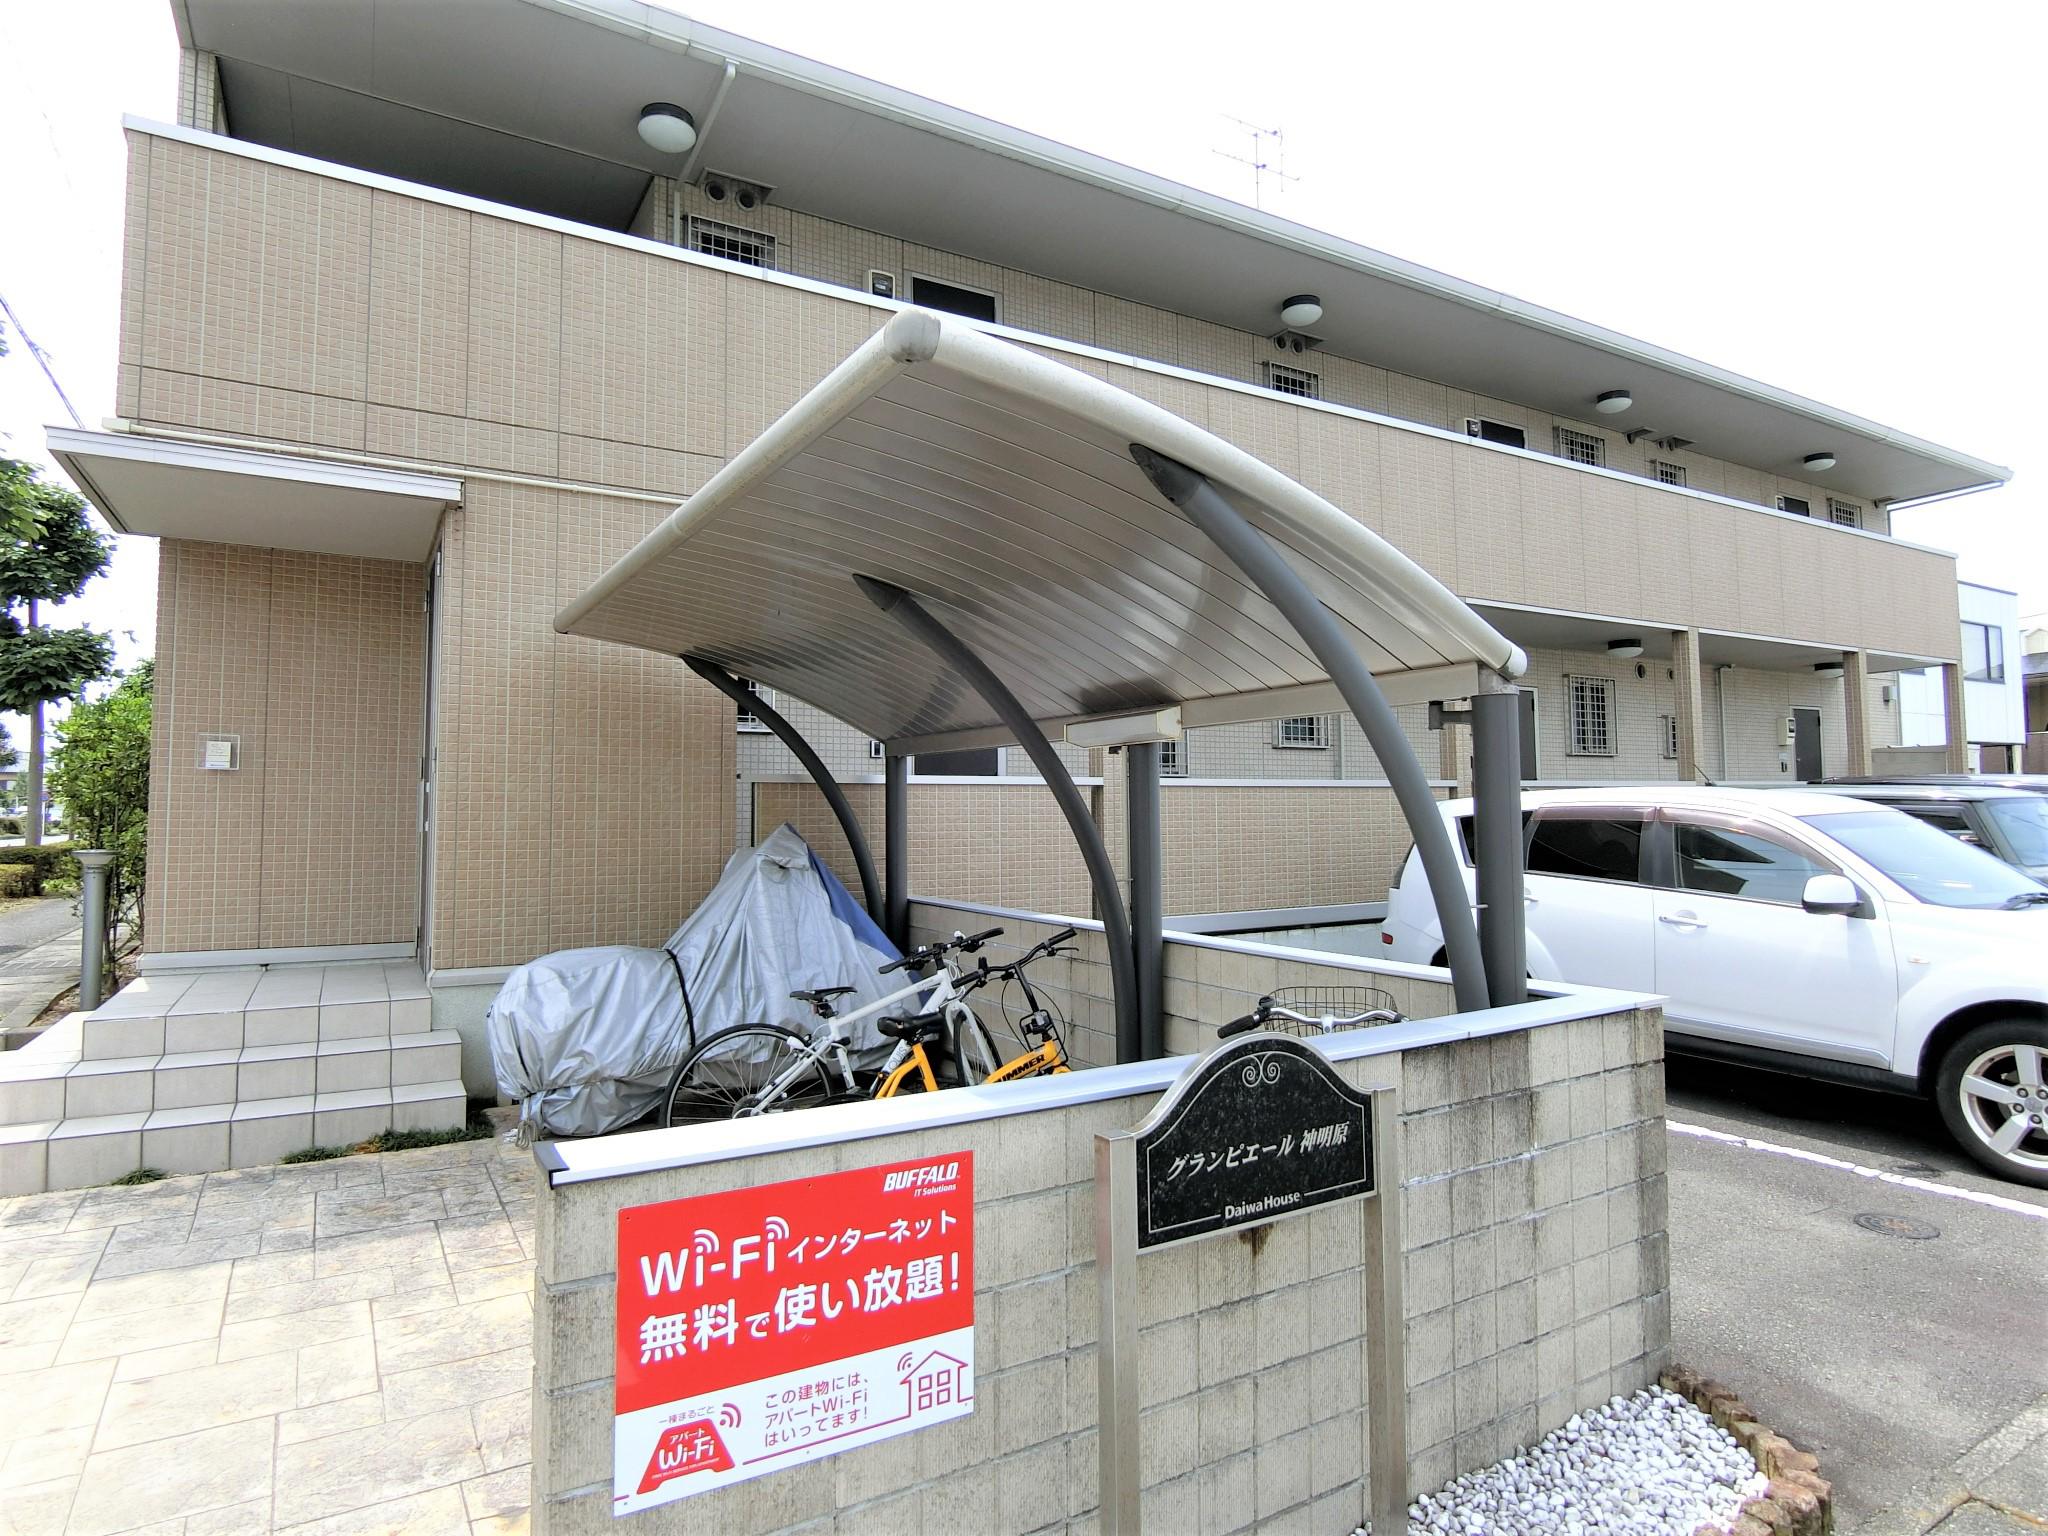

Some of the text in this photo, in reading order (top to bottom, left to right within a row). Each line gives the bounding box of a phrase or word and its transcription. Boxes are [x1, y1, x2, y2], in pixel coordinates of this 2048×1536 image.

[1167, 1121, 1350, 1182] グランピエール 神明原
[883, 1162, 959, 1192] BUFFALO
[914, 1183, 957, 1197] IT Solutions
[1225, 1192, 1300, 1220] Daiwa House
[670, 1427, 705, 1445] アパート
[659, 1435, 715, 1470] Wi-Fi
